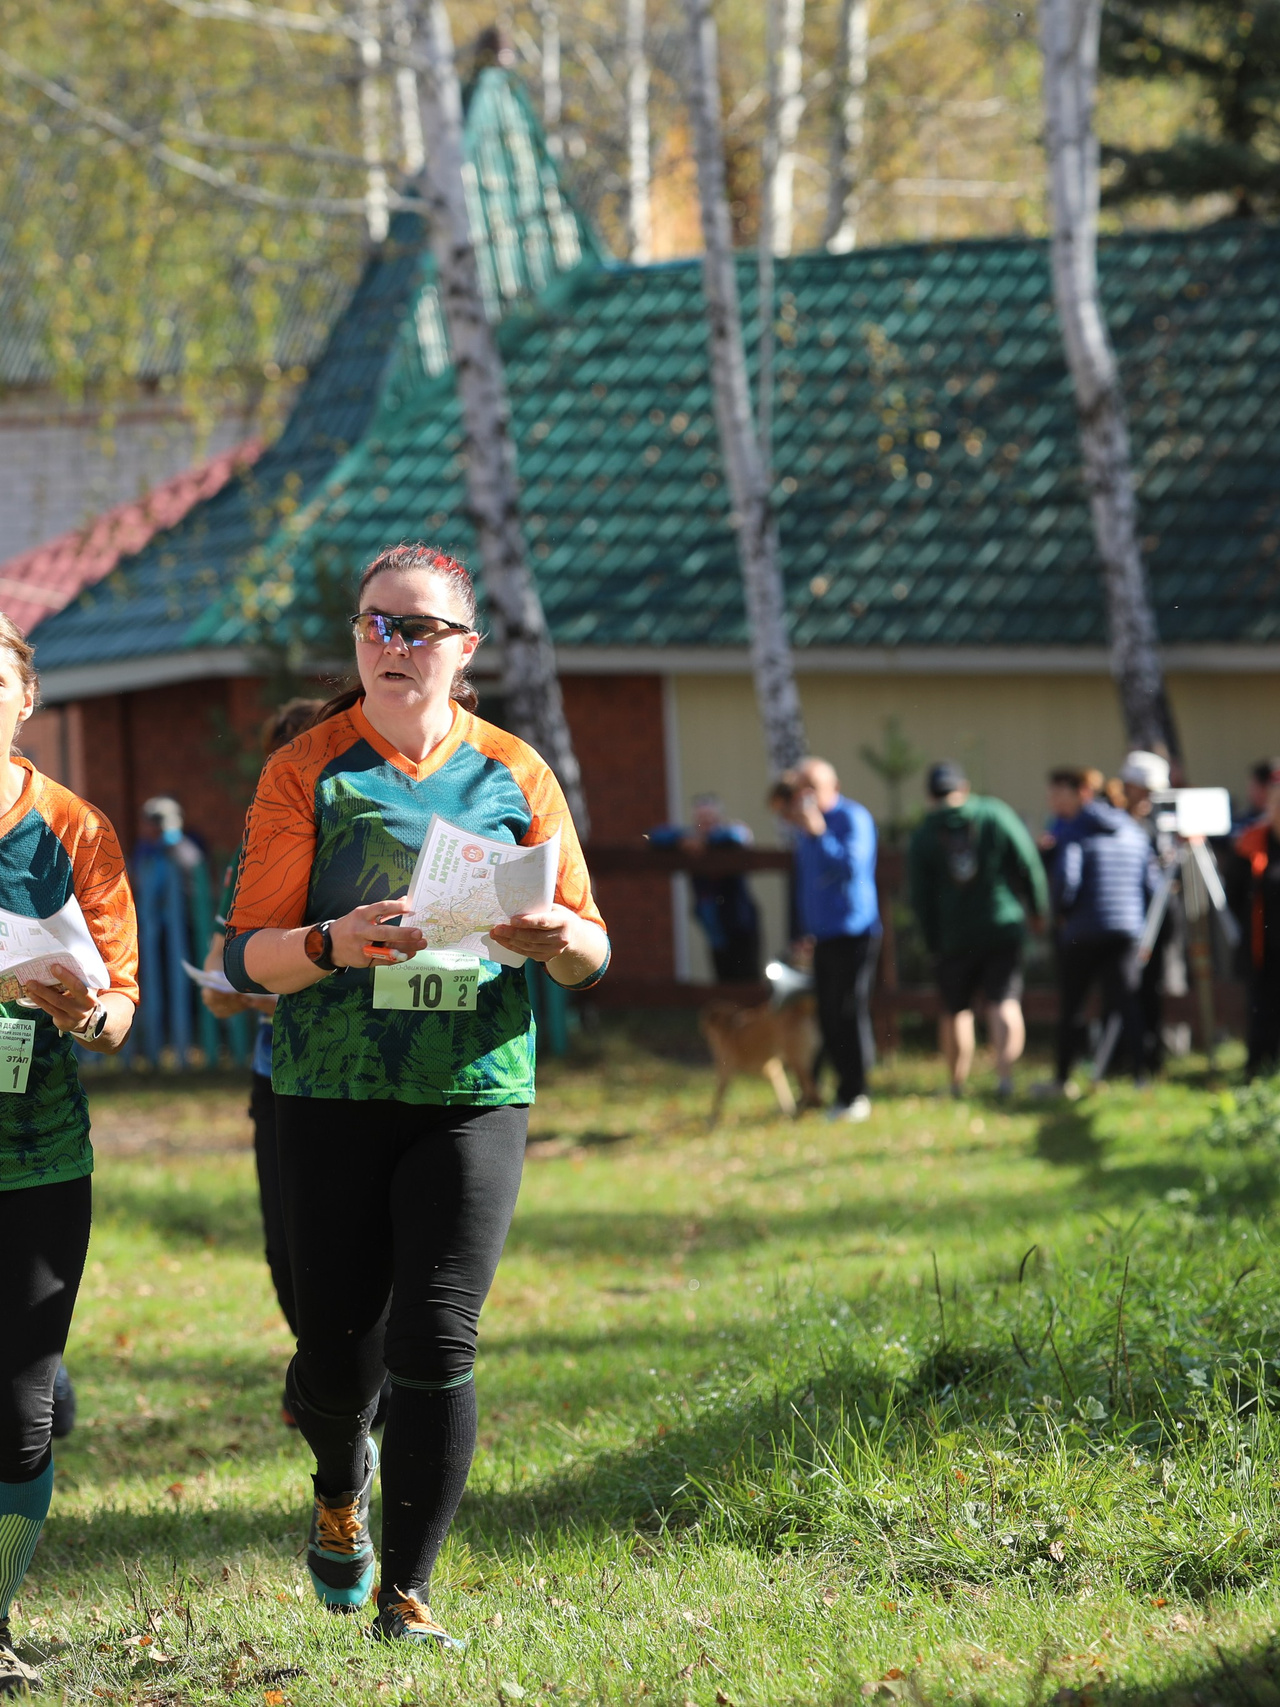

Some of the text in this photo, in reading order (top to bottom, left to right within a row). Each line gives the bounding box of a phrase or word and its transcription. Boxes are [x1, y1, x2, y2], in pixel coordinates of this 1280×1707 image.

[408, 974, 442, 1008] 10
[457, 983, 467, 1007] 2
[3, 1022, 32, 1031] ДЕСЯТКА
[6, 1056, 29, 1064] ЭТАП
[12, 1065, 20, 1088] 1
